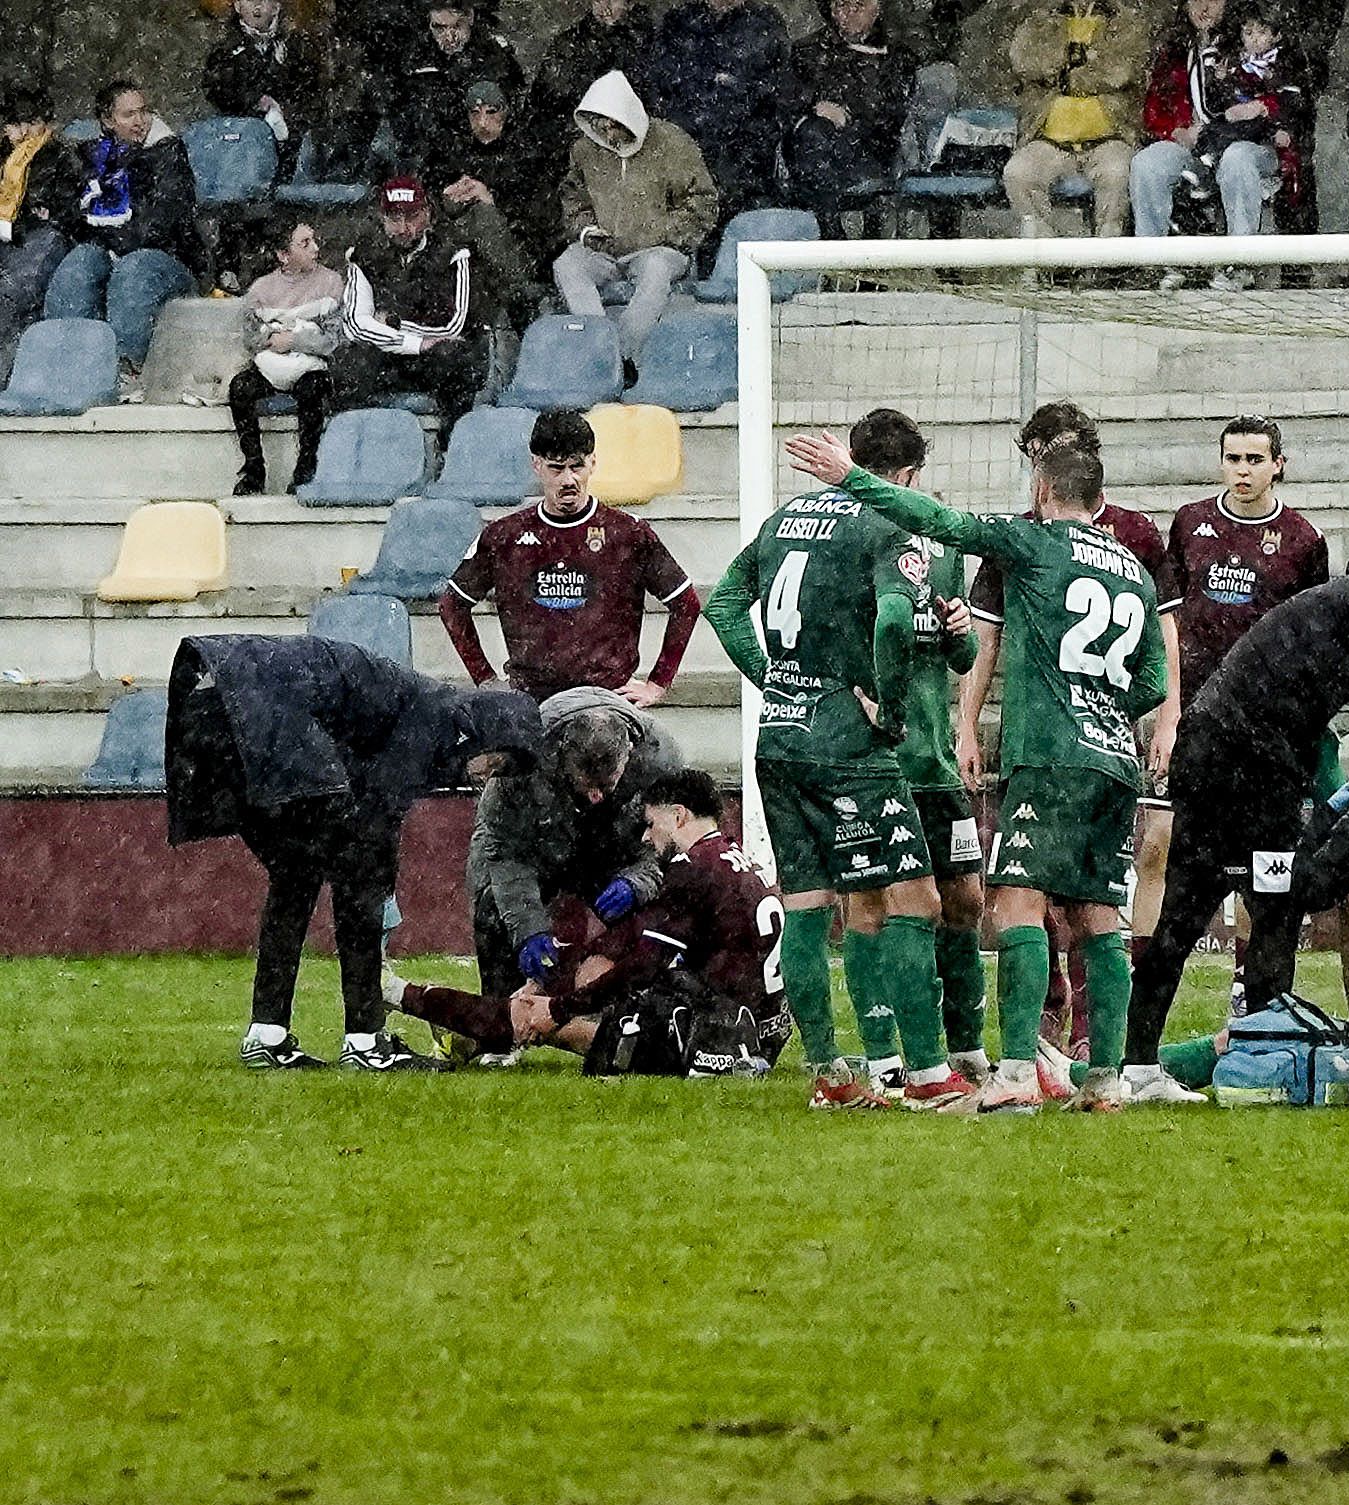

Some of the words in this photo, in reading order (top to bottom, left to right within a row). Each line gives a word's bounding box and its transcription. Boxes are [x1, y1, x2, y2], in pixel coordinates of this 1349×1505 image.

[785, 498, 862, 517] ABANCA
[1071, 541, 1124, 577] JORDAN
[537, 571, 584, 584] Estrella
[1208, 562, 1256, 582] Estrella
[538, 583, 582, 596] Galicia
[1208, 576, 1251, 593] Galicia
[767, 550, 810, 649] 4
[1059, 576, 1146, 692] 22
[762, 702, 807, 722] opeixe
